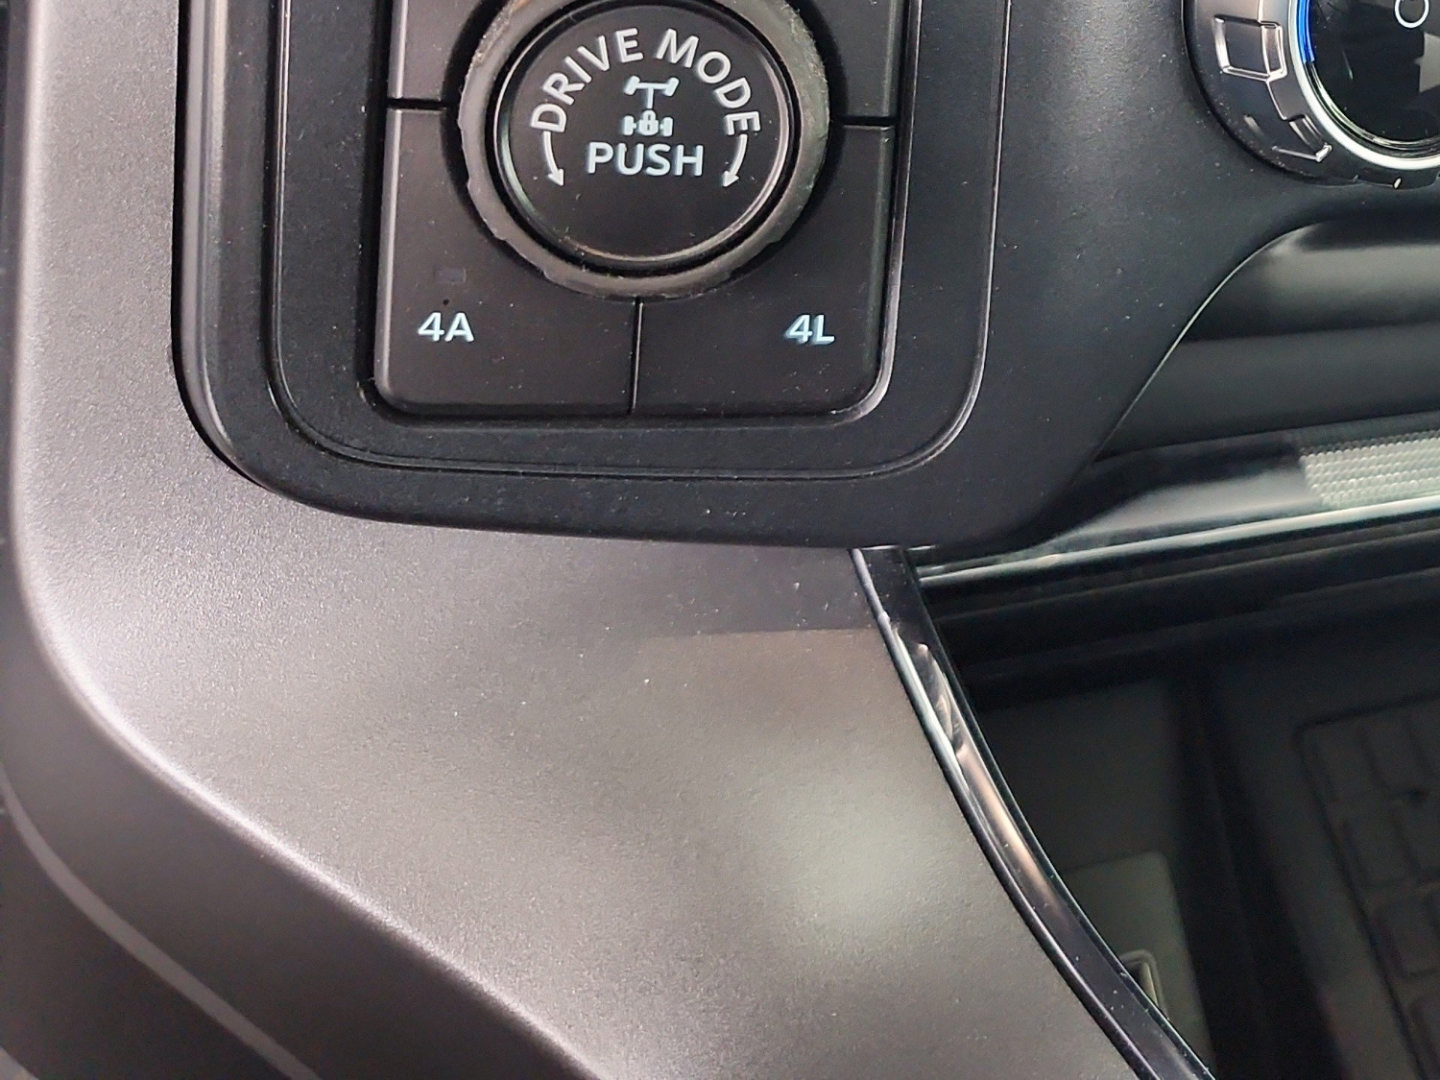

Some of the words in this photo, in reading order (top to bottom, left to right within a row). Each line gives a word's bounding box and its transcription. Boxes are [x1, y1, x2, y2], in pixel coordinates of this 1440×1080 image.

[530, 28, 645, 134] DRIVE
[655, 28, 761, 136] MODE
[586, 142, 704, 176] PUSH
[417, 312, 475, 343] 4A
[783, 314, 835, 346] 4L
